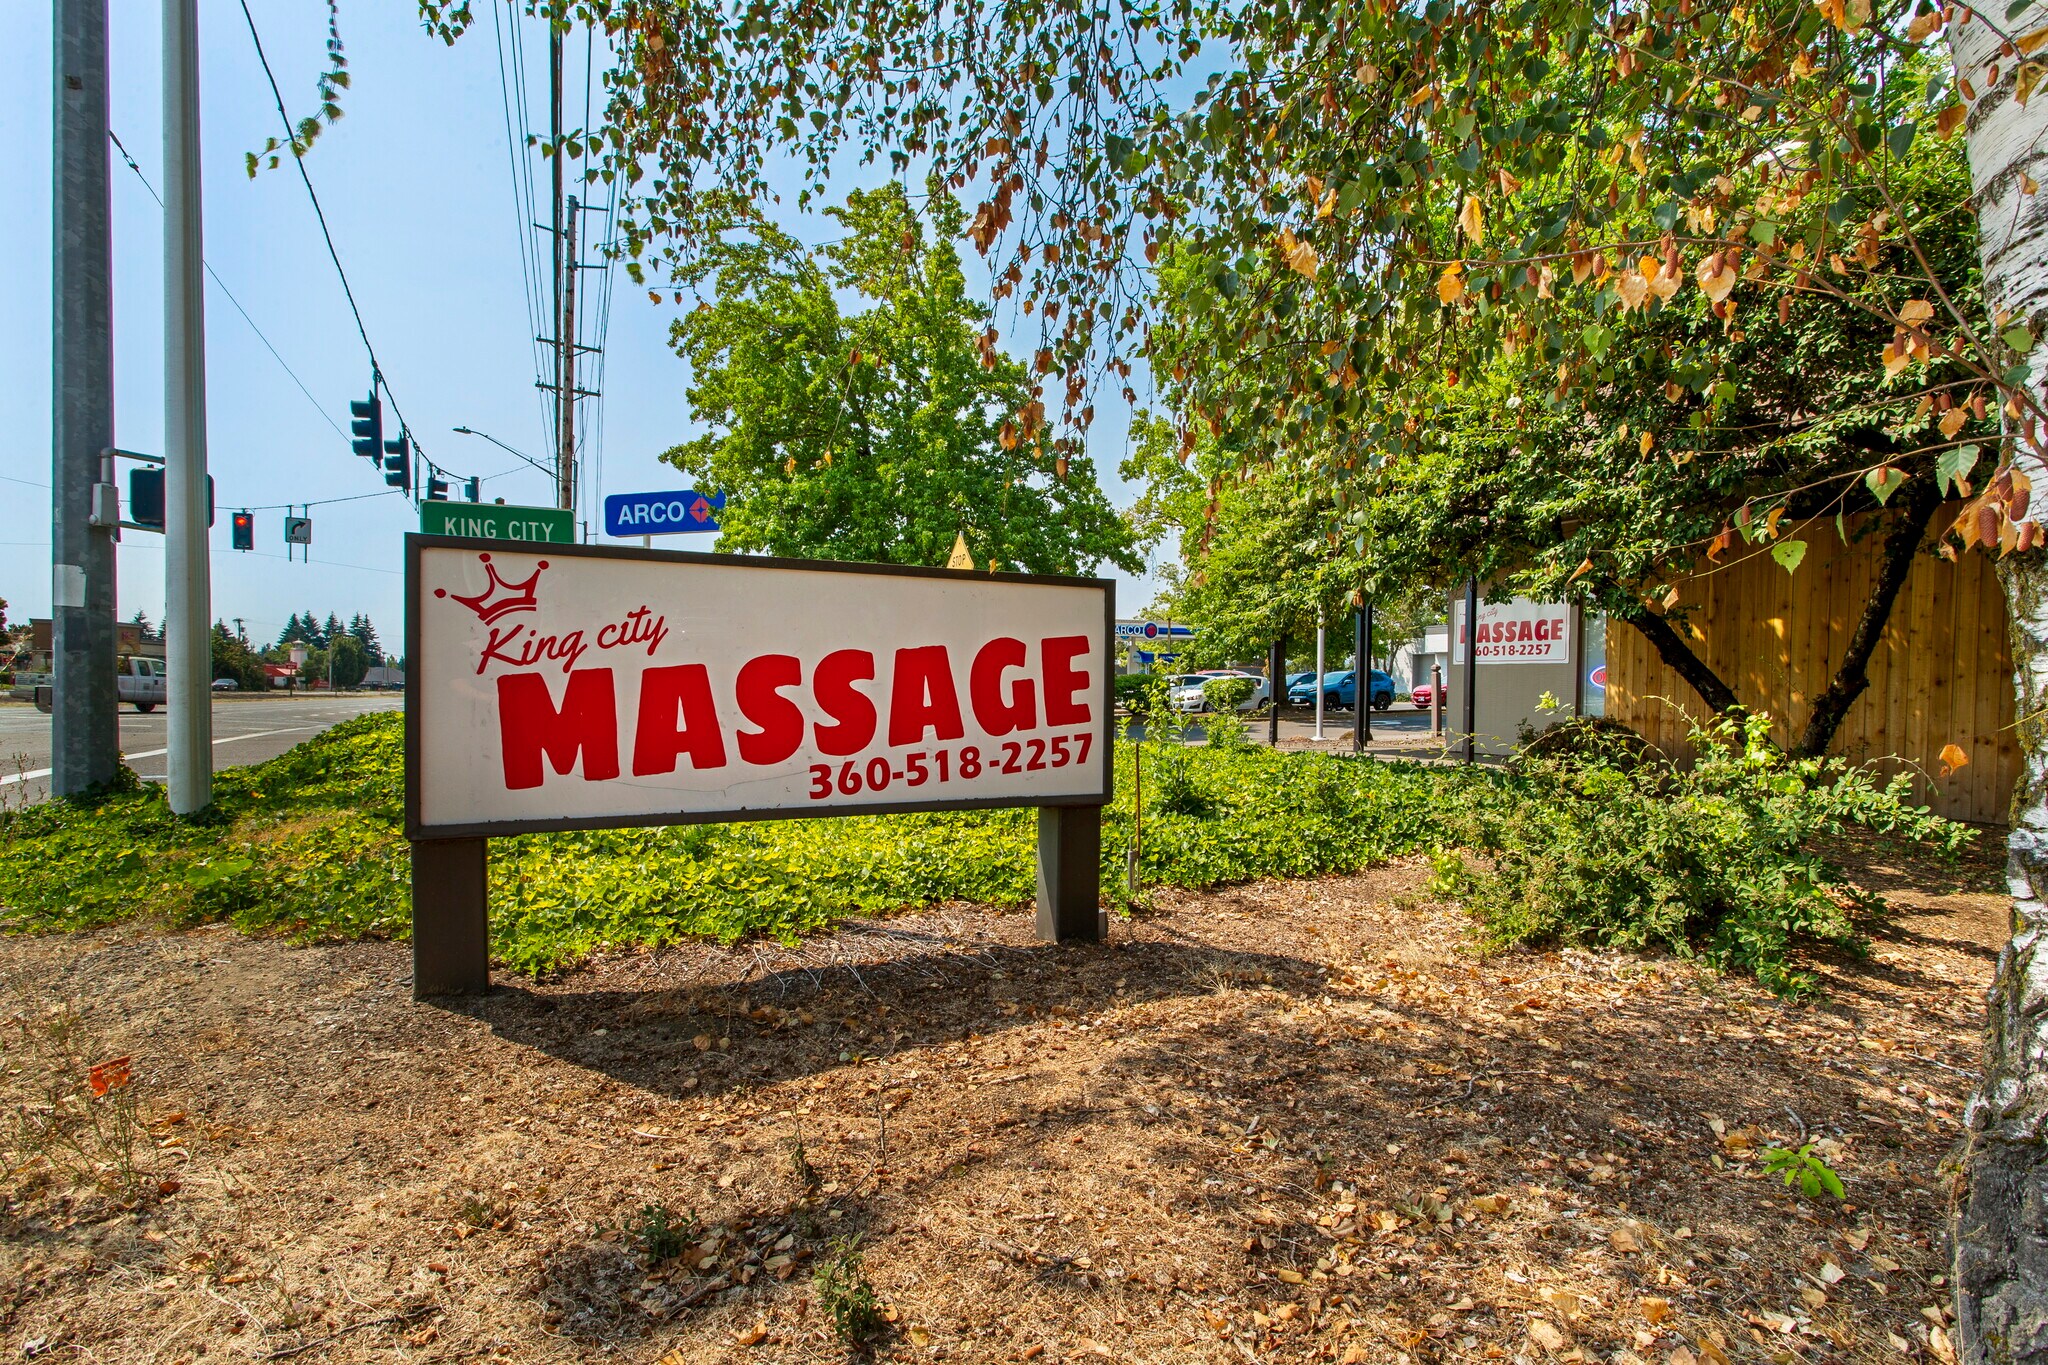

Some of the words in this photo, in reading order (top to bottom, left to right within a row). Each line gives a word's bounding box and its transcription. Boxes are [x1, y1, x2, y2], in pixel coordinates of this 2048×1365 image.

[618, 501, 685, 525] ARCO
[445, 517, 496, 538] KING
[508, 521, 554, 542] CITY
[476, 624, 588, 675] King
[597, 605, 669, 656] city
[1115, 625, 1141, 635] ARCO
[1460, 619, 1563, 644] ASSAGE
[1475, 644, 1551, 656] 60-518-2257
[496, 634, 1092, 790] MASSAGE
[809, 732, 1093, 799] 360-518-2257
